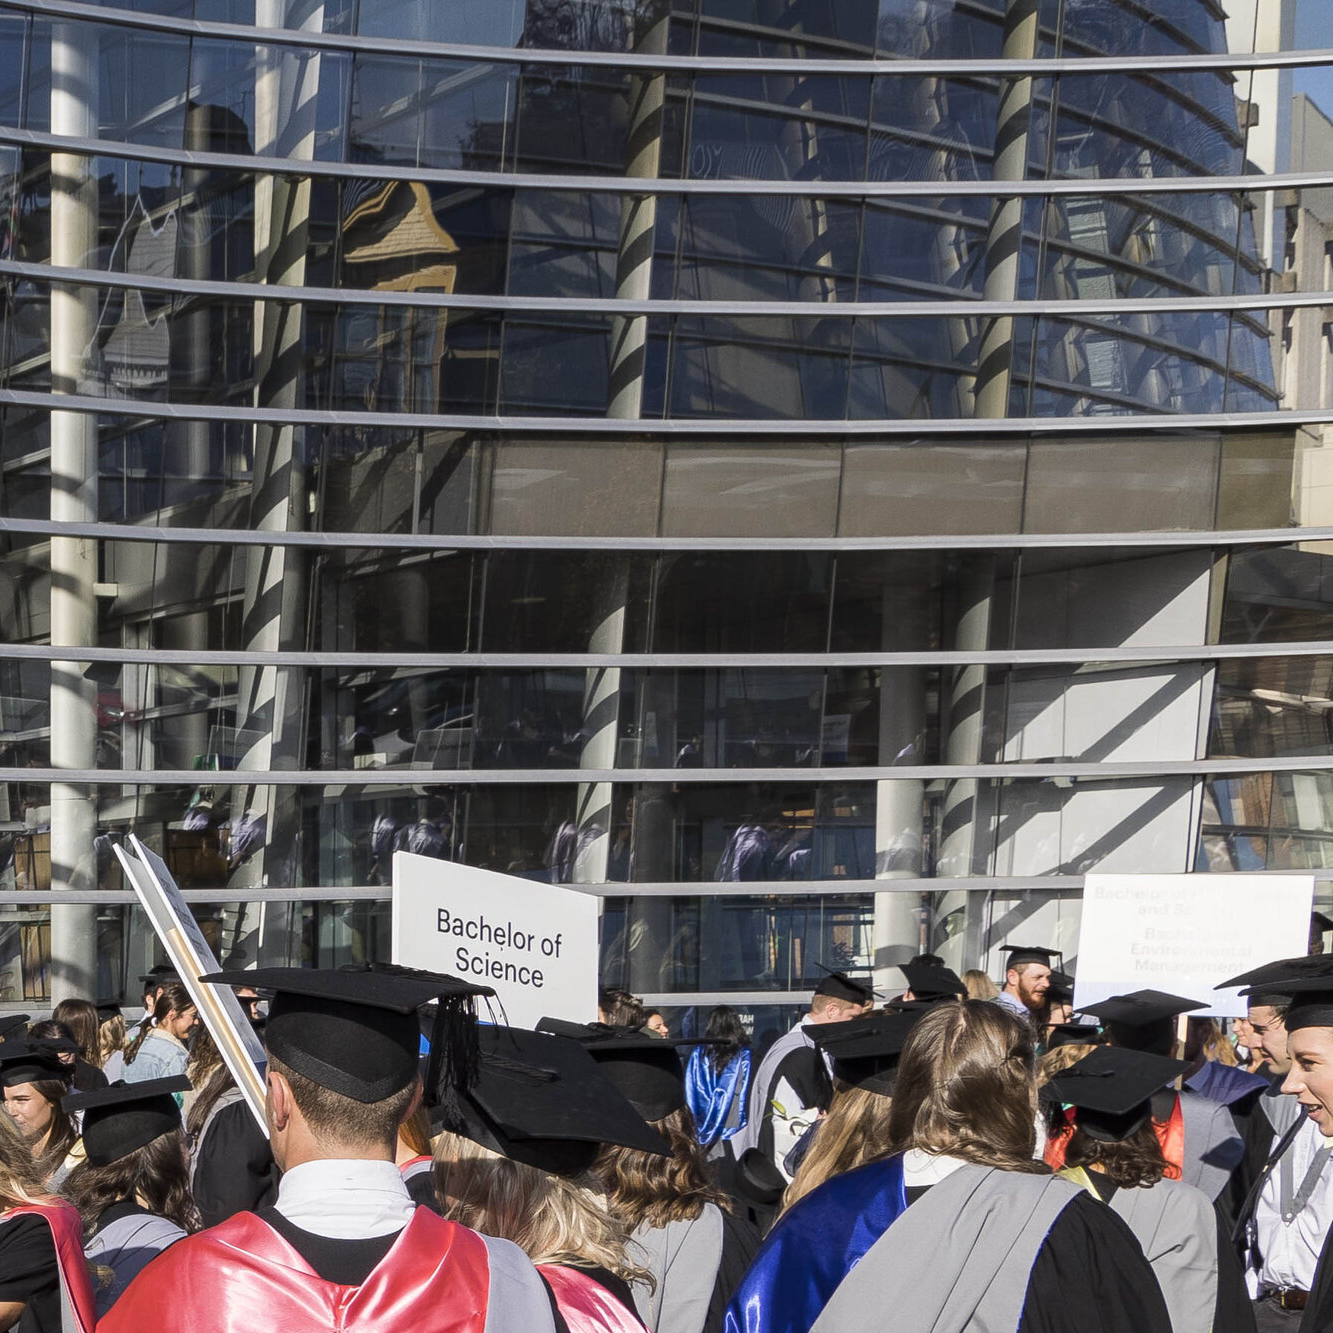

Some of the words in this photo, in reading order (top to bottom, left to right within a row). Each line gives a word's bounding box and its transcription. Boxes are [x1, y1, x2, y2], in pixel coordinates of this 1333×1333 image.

[437, 907, 535, 952] Bachelor
[540, 933, 563, 959] of
[455, 946, 544, 988] Science
